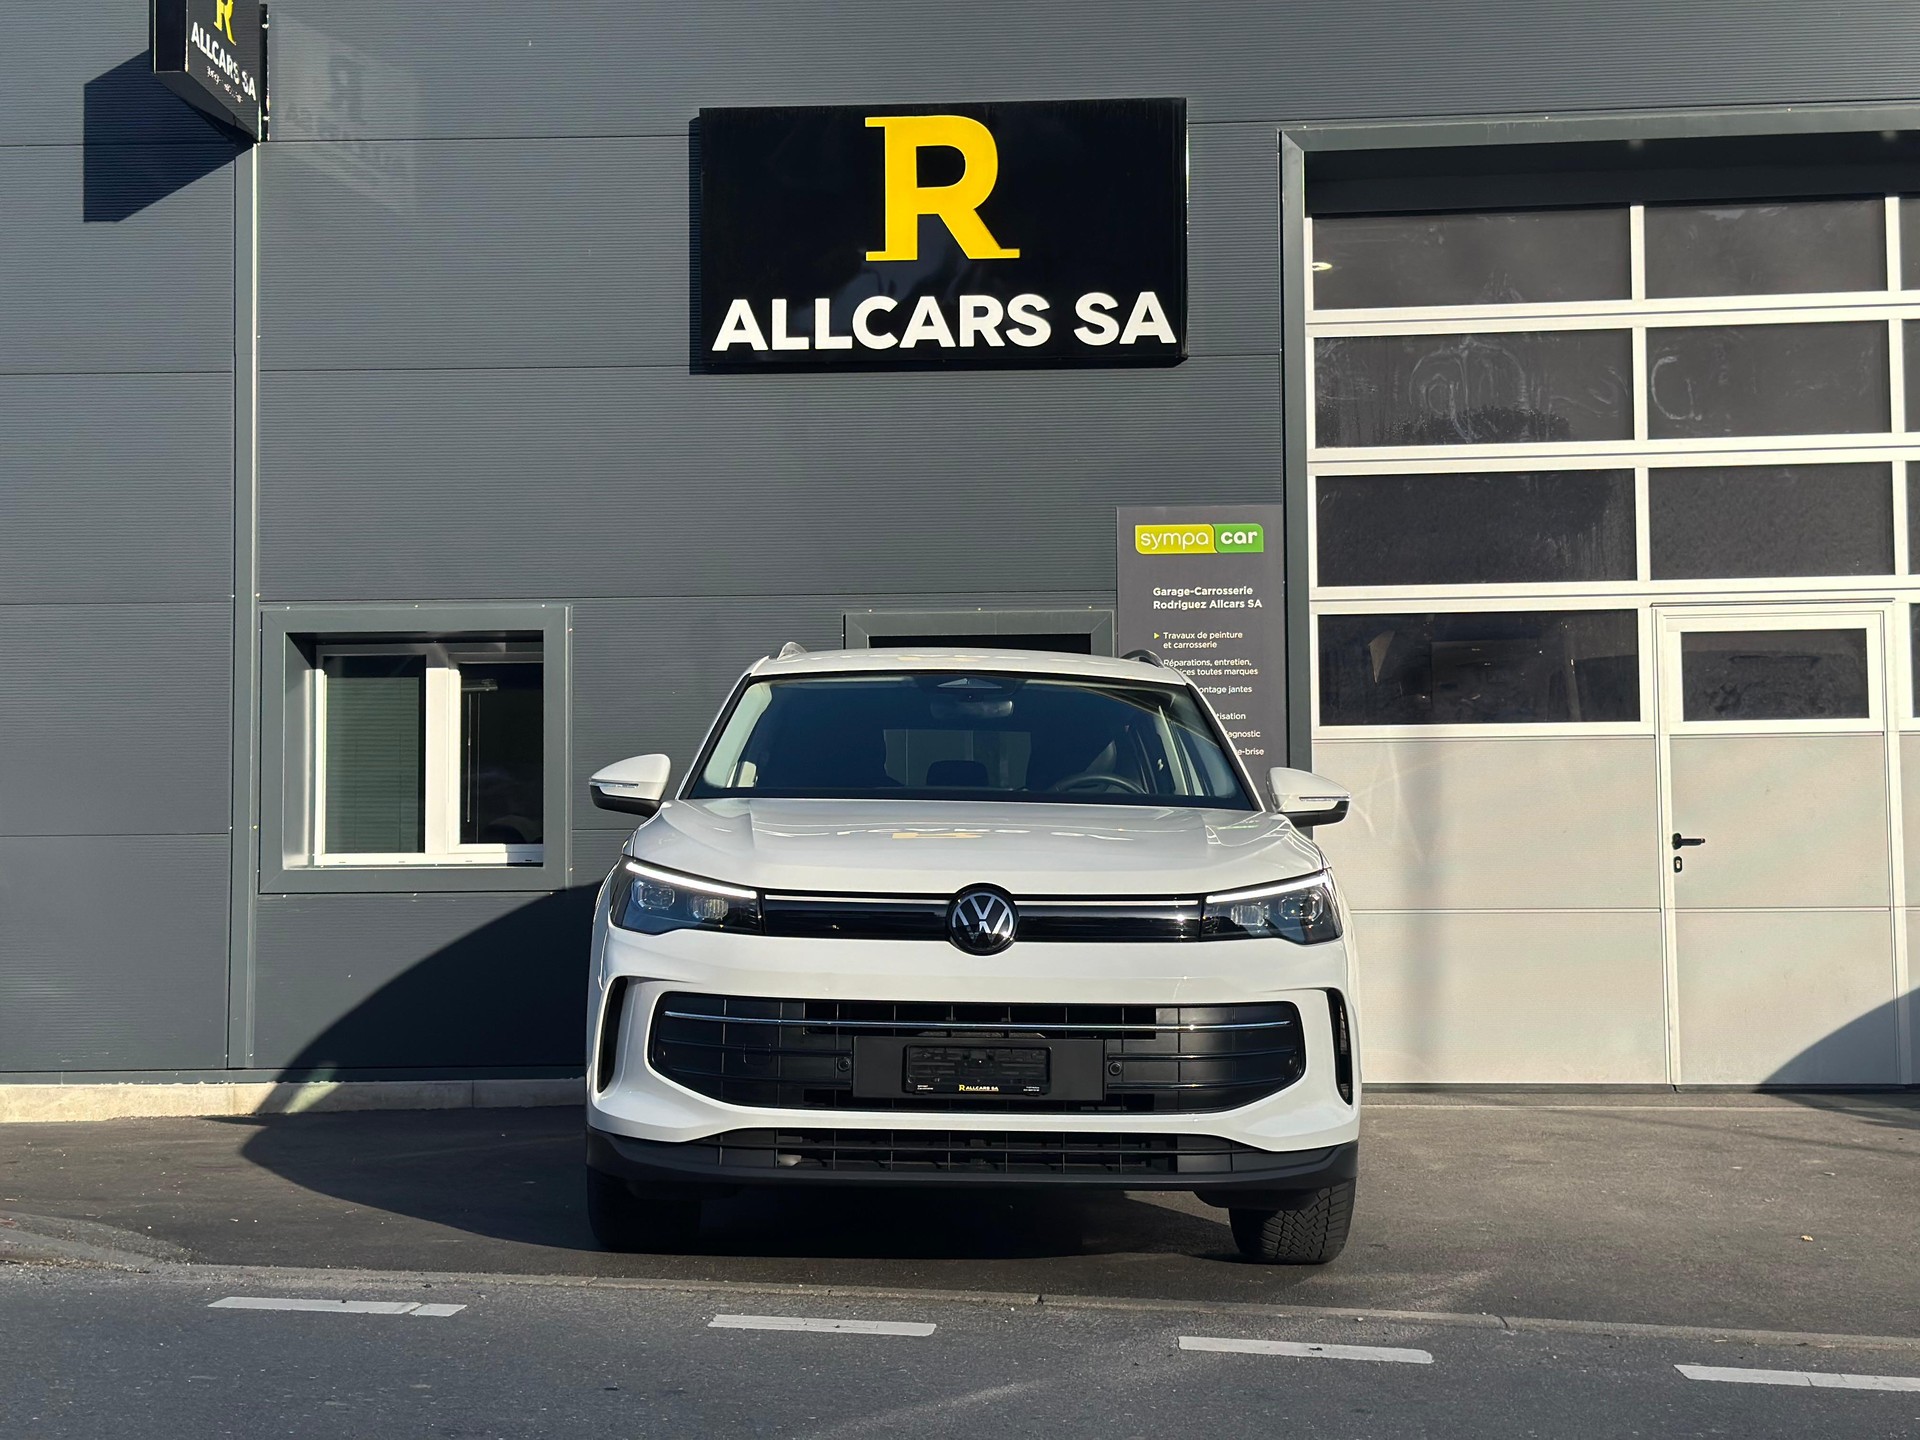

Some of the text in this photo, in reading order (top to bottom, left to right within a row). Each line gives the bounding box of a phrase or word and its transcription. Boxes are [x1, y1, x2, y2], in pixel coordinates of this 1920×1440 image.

[191, 22, 240, 85] ALLCARS
[241, 71, 257, 101] SA
[865, 115, 1020, 262] R
[711, 291, 1177, 352] ALLCARS SA
[1140, 531, 1258, 550] sympa car
[1153, 586, 1254, 597] Garage-Carrosserie
[1153, 599, 1263, 610] Rodriguez Allcars SA
[1197, 631, 1208, 639] de
[1209, 631, 1243, 641] peinture
[1163, 641, 1218, 649] et carrosserie
[1197, 668, 1222, 676] toutes
[1224, 668, 1259, 678] marques
[1198, 685, 1253, 695] ontage jantes
